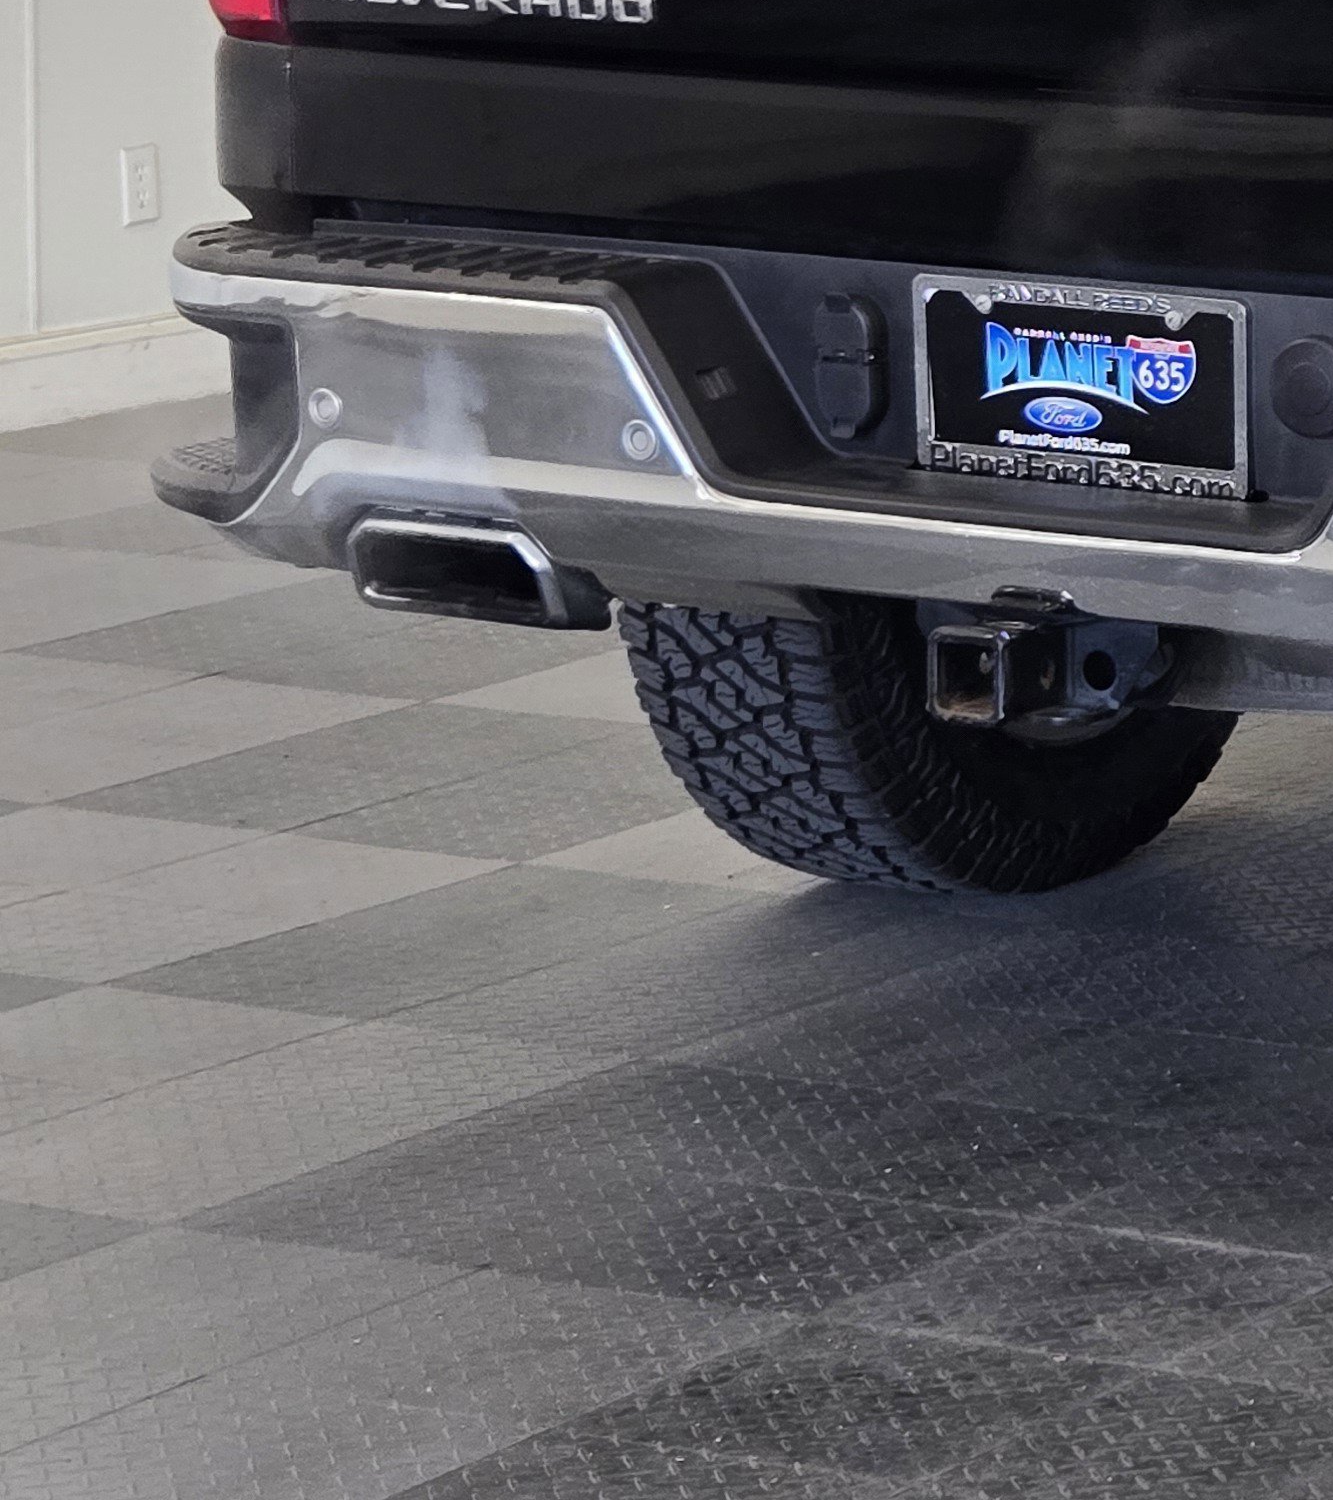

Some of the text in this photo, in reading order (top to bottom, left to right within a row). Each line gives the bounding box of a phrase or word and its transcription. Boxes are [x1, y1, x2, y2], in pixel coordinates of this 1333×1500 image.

[984, 321, 1186, 404] PLANET 635
[1040, 403, 1087, 429] Ford
